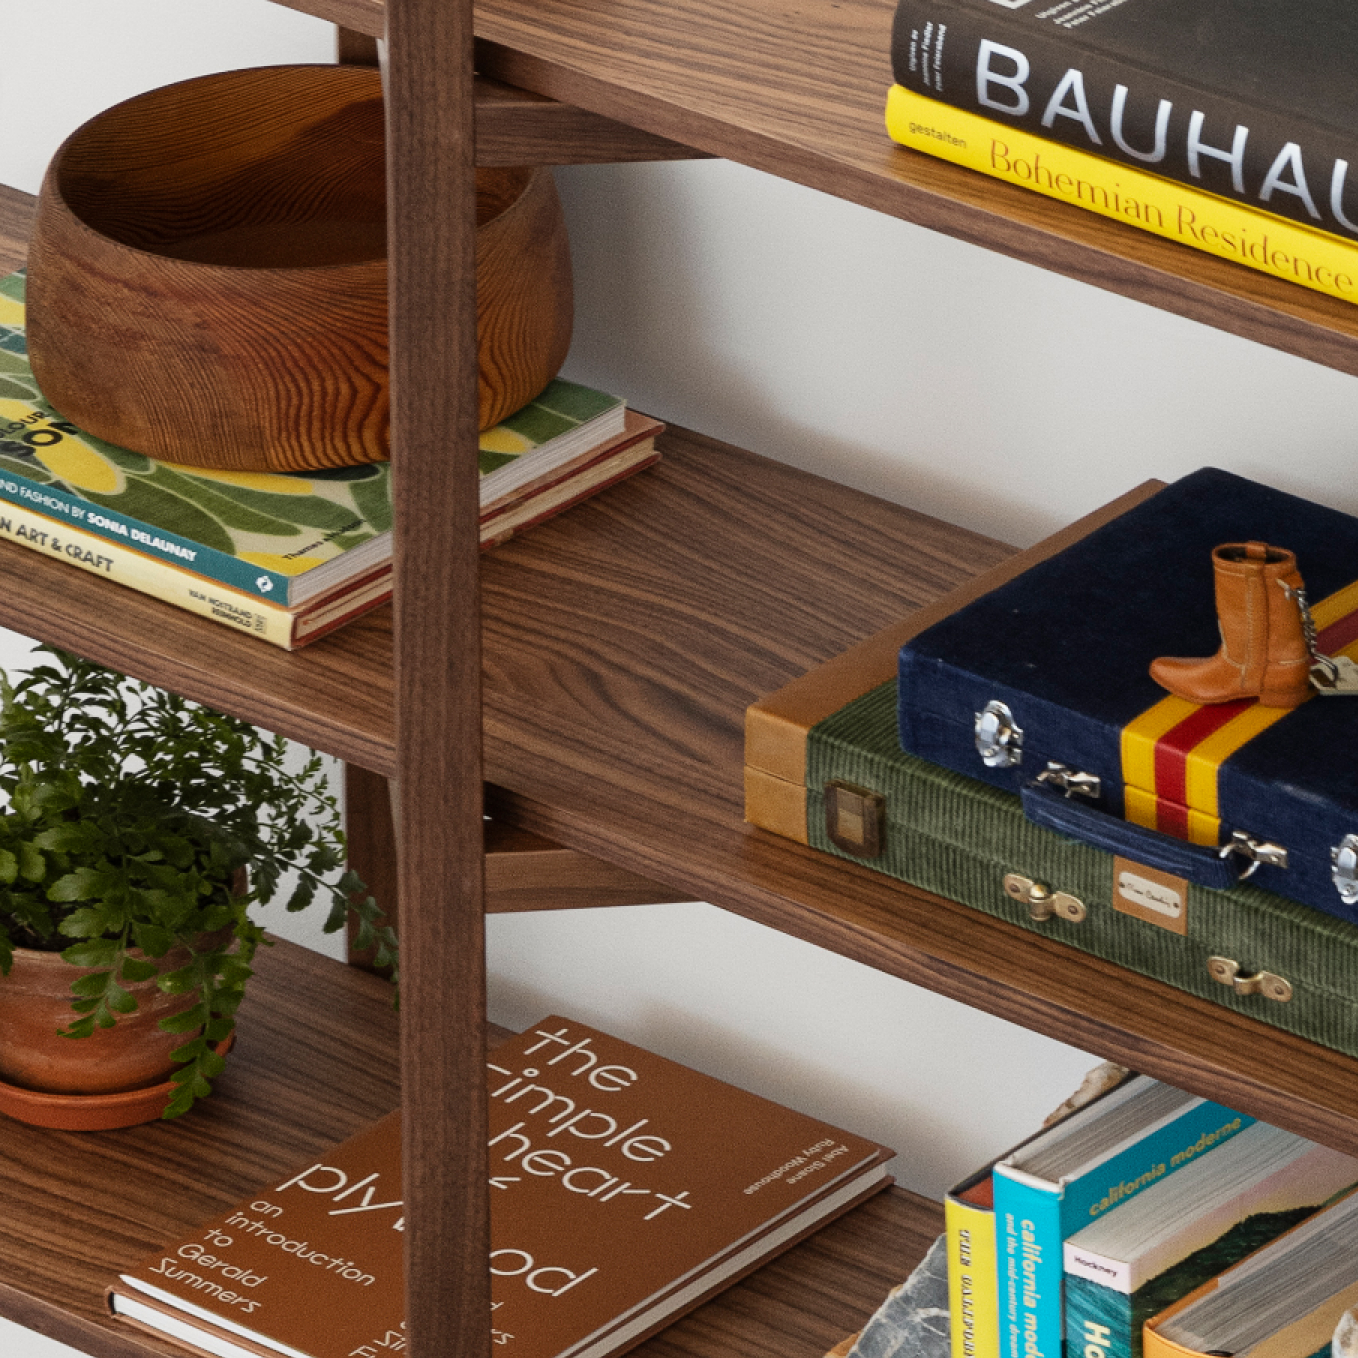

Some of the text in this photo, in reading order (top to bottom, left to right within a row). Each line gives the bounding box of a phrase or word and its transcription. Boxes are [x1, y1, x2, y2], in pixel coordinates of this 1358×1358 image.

[908, 120, 967, 150] gestalten
[988, 137, 1354, 296] Bohemian Residence
[0, 411, 50, 438] LOUR
[0, 478, 198, 562] ND FASHION BY SONIA DELAUNAY
[16, 522, 49, 547] ART
[50, 537, 63, 553] &
[65, 543, 115, 573] CRAFT
[524, 1029, 638, 1091] the
[488, 1122, 692, 1221] heart
[743, 1138, 836, 1195] Ruby Woodhouse
[1089, 1118, 1243, 1216] california moderne
[250, 1200, 283, 1218] an
[1005, 1212, 1018, 1236] and
[204, 1228, 233, 1248] to
[225, 1212, 375, 1287] introduction
[958, 1229, 972, 1267] THE
[1006, 1236, 1018, 1254] the
[1020, 1219, 1042, 1308] california
[149, 1257, 262, 1315] Summers
[177, 1244, 268, 1288] Gerald
[1007, 1257, 1019, 1323] mid-century
[1073, 1255, 1118, 1277] Hockney
